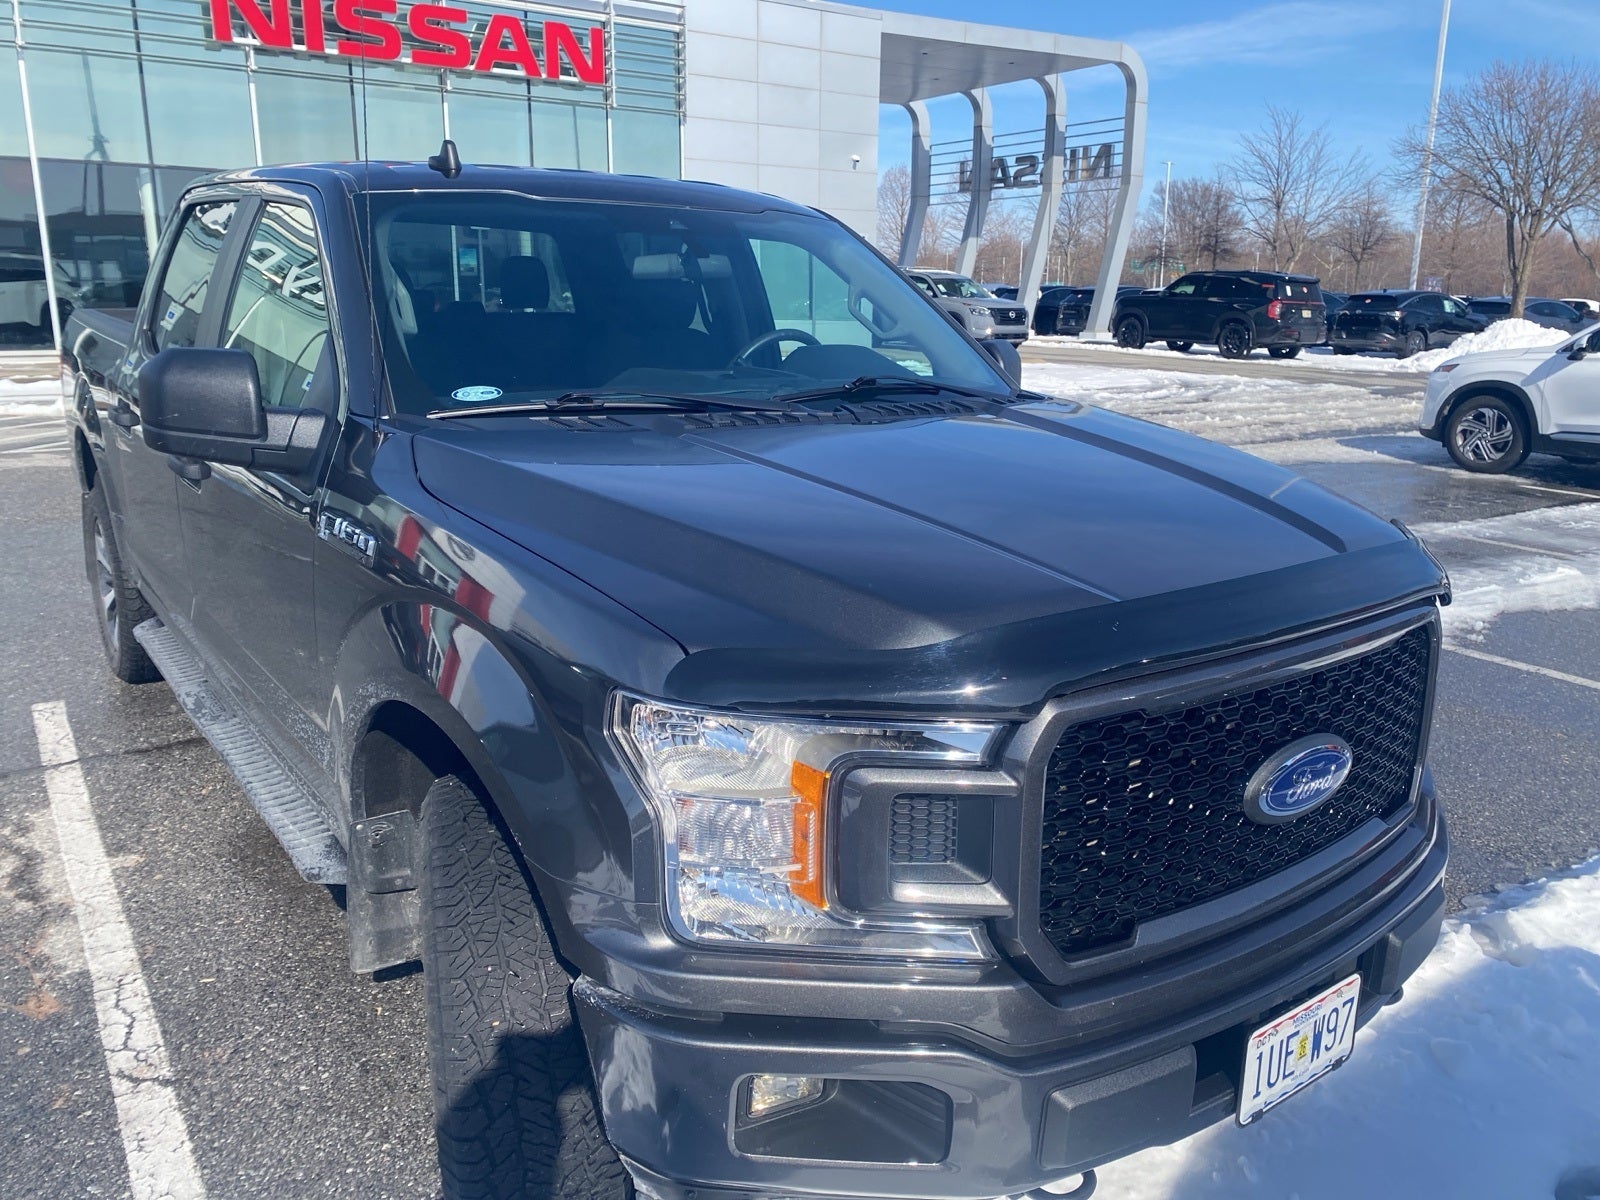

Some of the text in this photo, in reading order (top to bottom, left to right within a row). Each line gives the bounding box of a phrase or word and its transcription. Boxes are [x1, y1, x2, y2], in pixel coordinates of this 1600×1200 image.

[210, 0, 605, 84] NISSAN
[1286, 761, 1336, 805] Ford
[1292, 1003, 1322, 1025] MISSOURI
[1252, 997, 1355, 1100] 1UE W97
